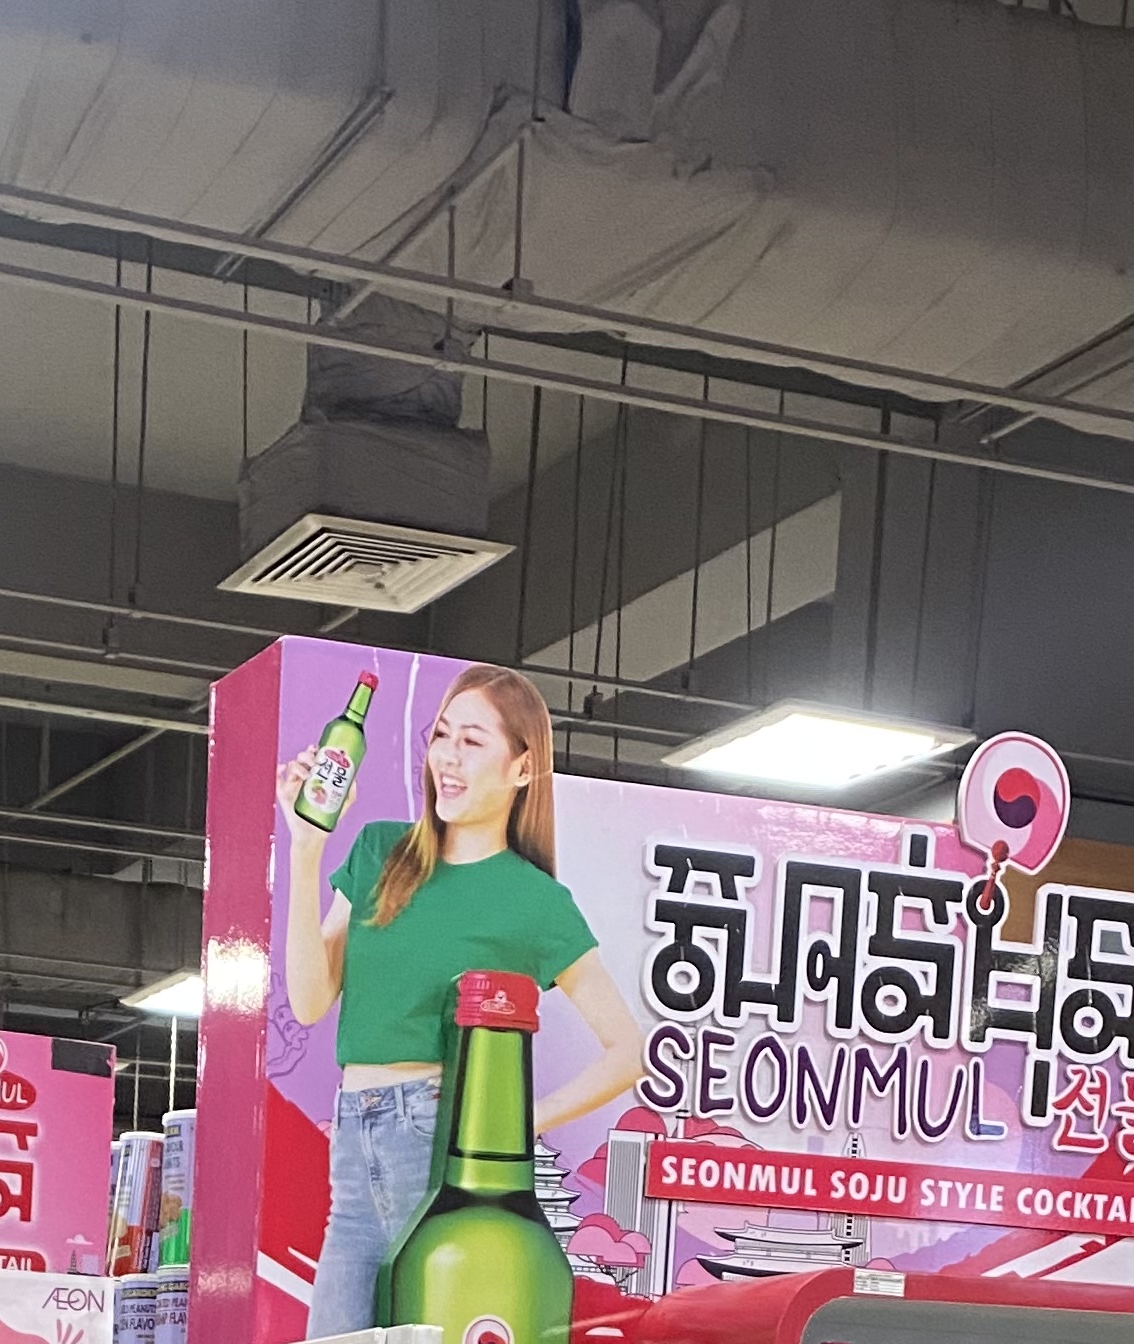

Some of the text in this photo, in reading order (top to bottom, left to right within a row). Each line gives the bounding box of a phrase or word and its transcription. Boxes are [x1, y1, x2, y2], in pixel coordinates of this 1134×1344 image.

[641, 1027, 1006, 1138] SEONMUL
[661, 1155, 817, 1197] SEONMUL
[830, 1170, 907, 1205] SOJU
[920, 1178, 1004, 1211] STYLE
